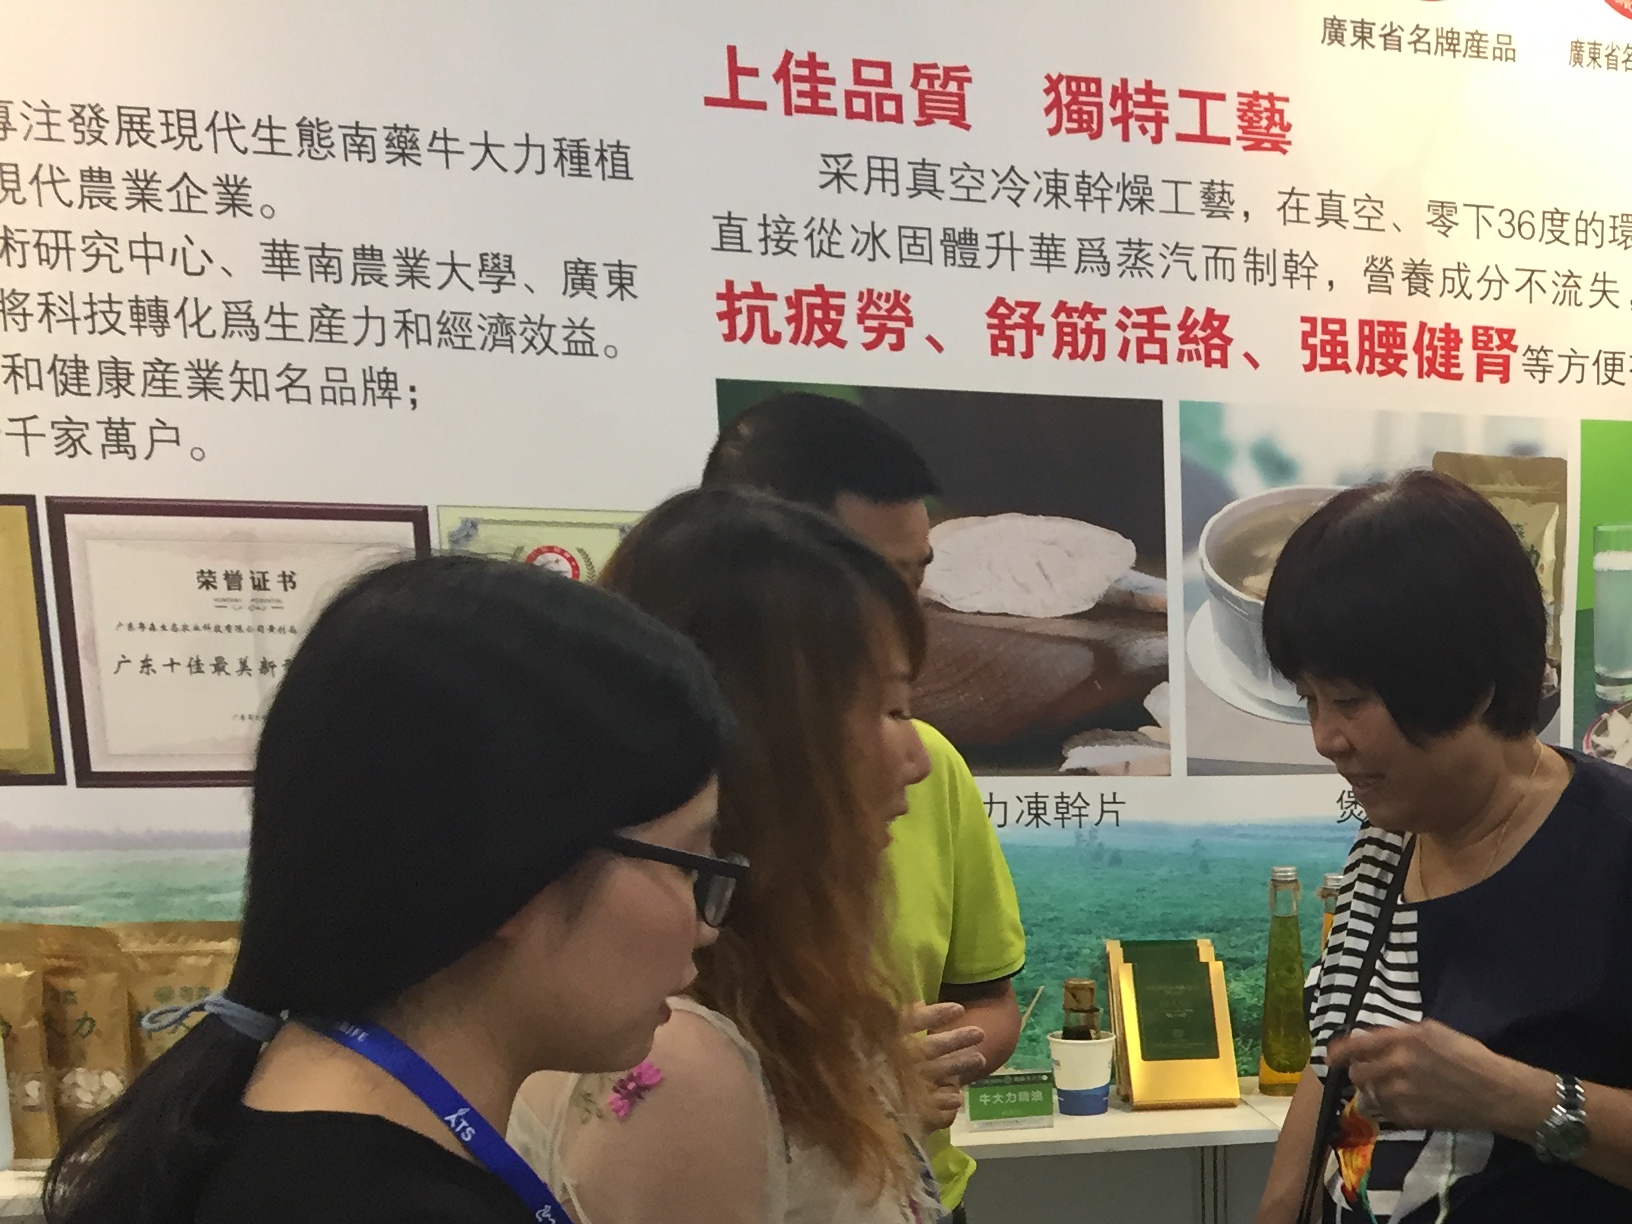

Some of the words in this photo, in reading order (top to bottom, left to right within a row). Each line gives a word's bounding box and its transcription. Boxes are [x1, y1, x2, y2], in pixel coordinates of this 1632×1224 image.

[1320, 14, 1517, 63] 廣東省名牌産品
[703, 44, 974, 133] 上佳品質
[1042, 71, 1293, 157] 獨特工藝
[196, 568, 298, 593] 荣誉证书
